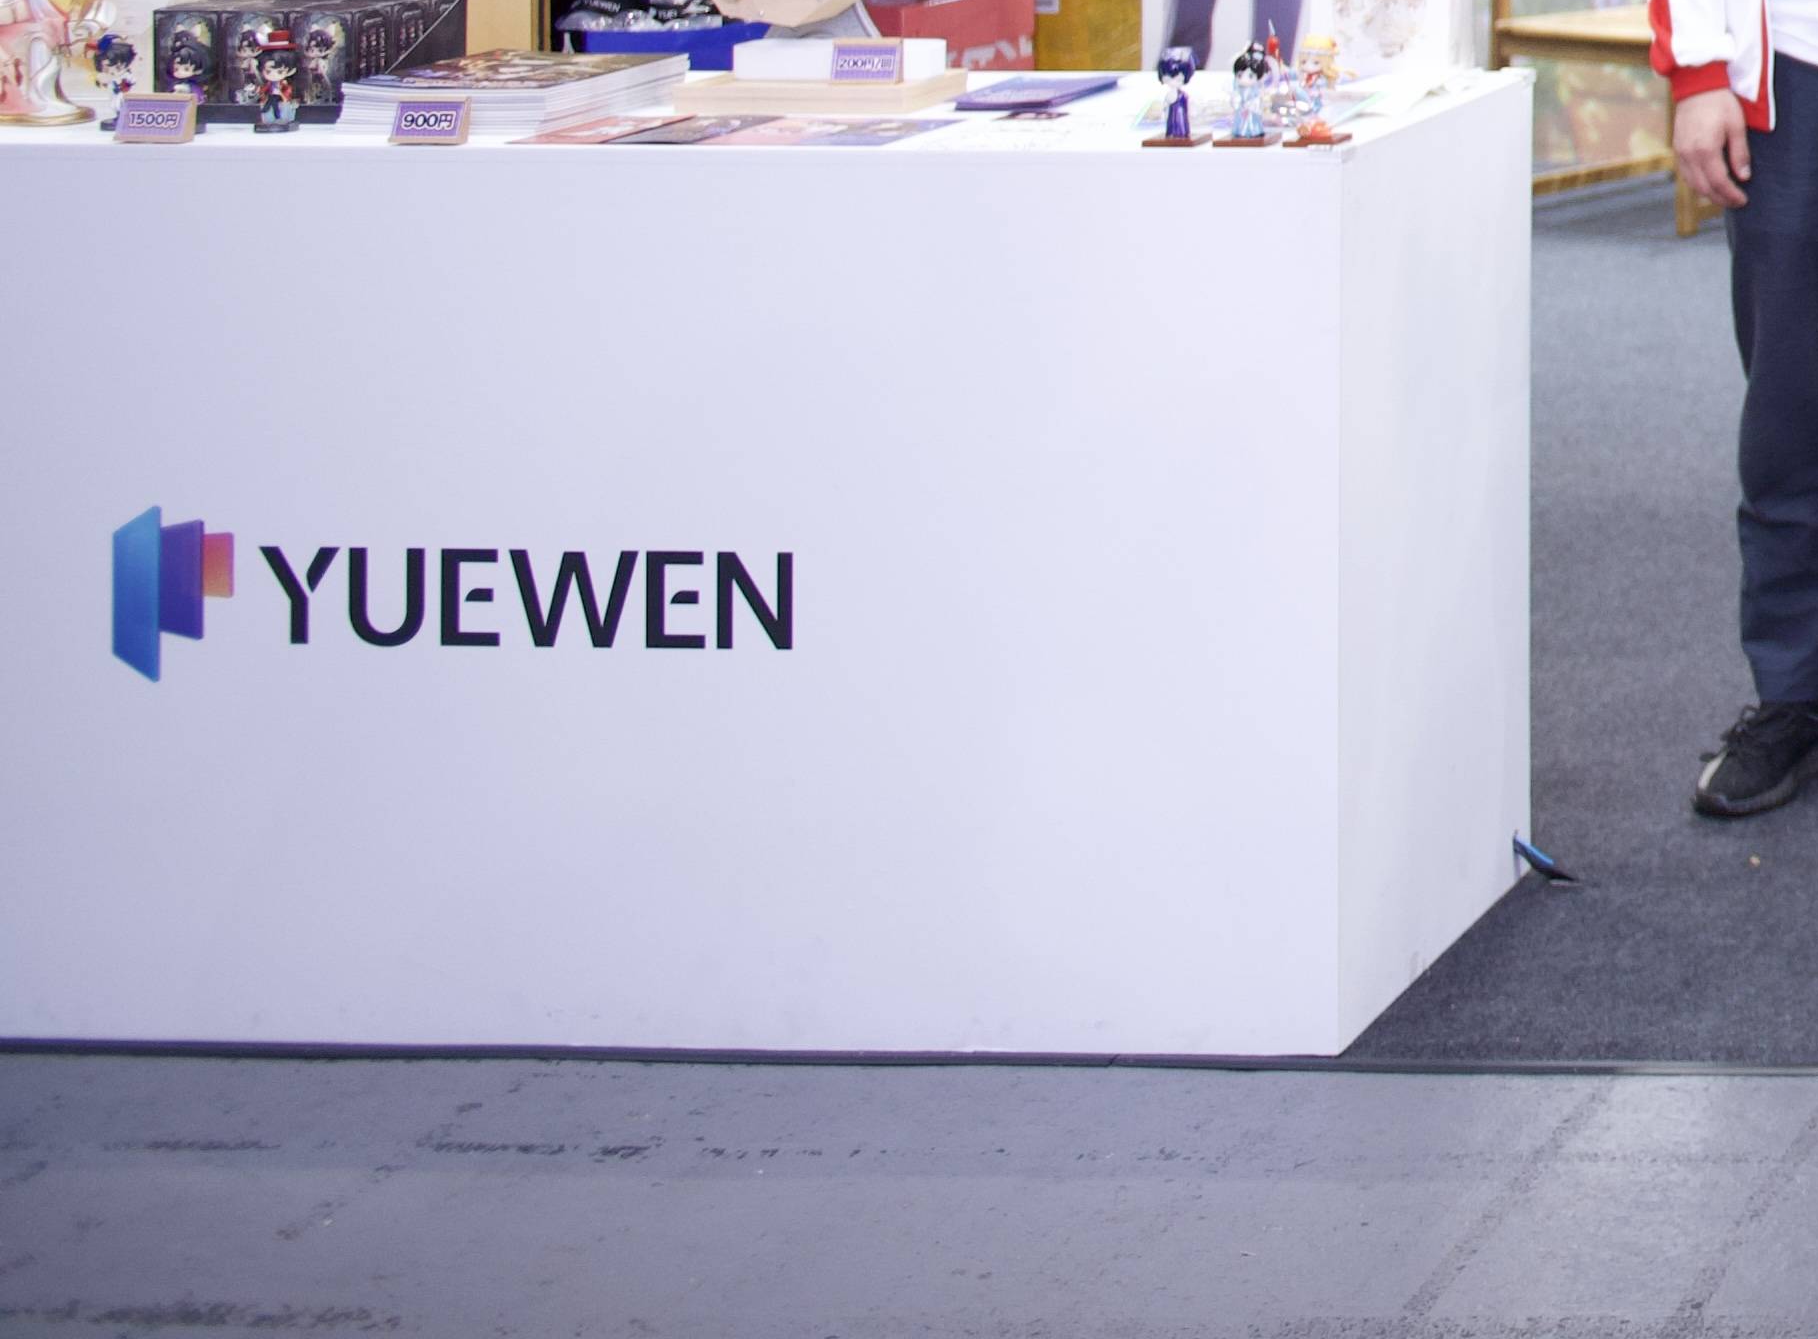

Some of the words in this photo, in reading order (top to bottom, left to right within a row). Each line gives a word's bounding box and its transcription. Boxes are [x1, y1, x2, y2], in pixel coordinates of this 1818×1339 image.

[129, 112, 178, 127] 1500円
[403, 112, 455, 129] 900円
[258, 545, 794, 650] YUEWEN
